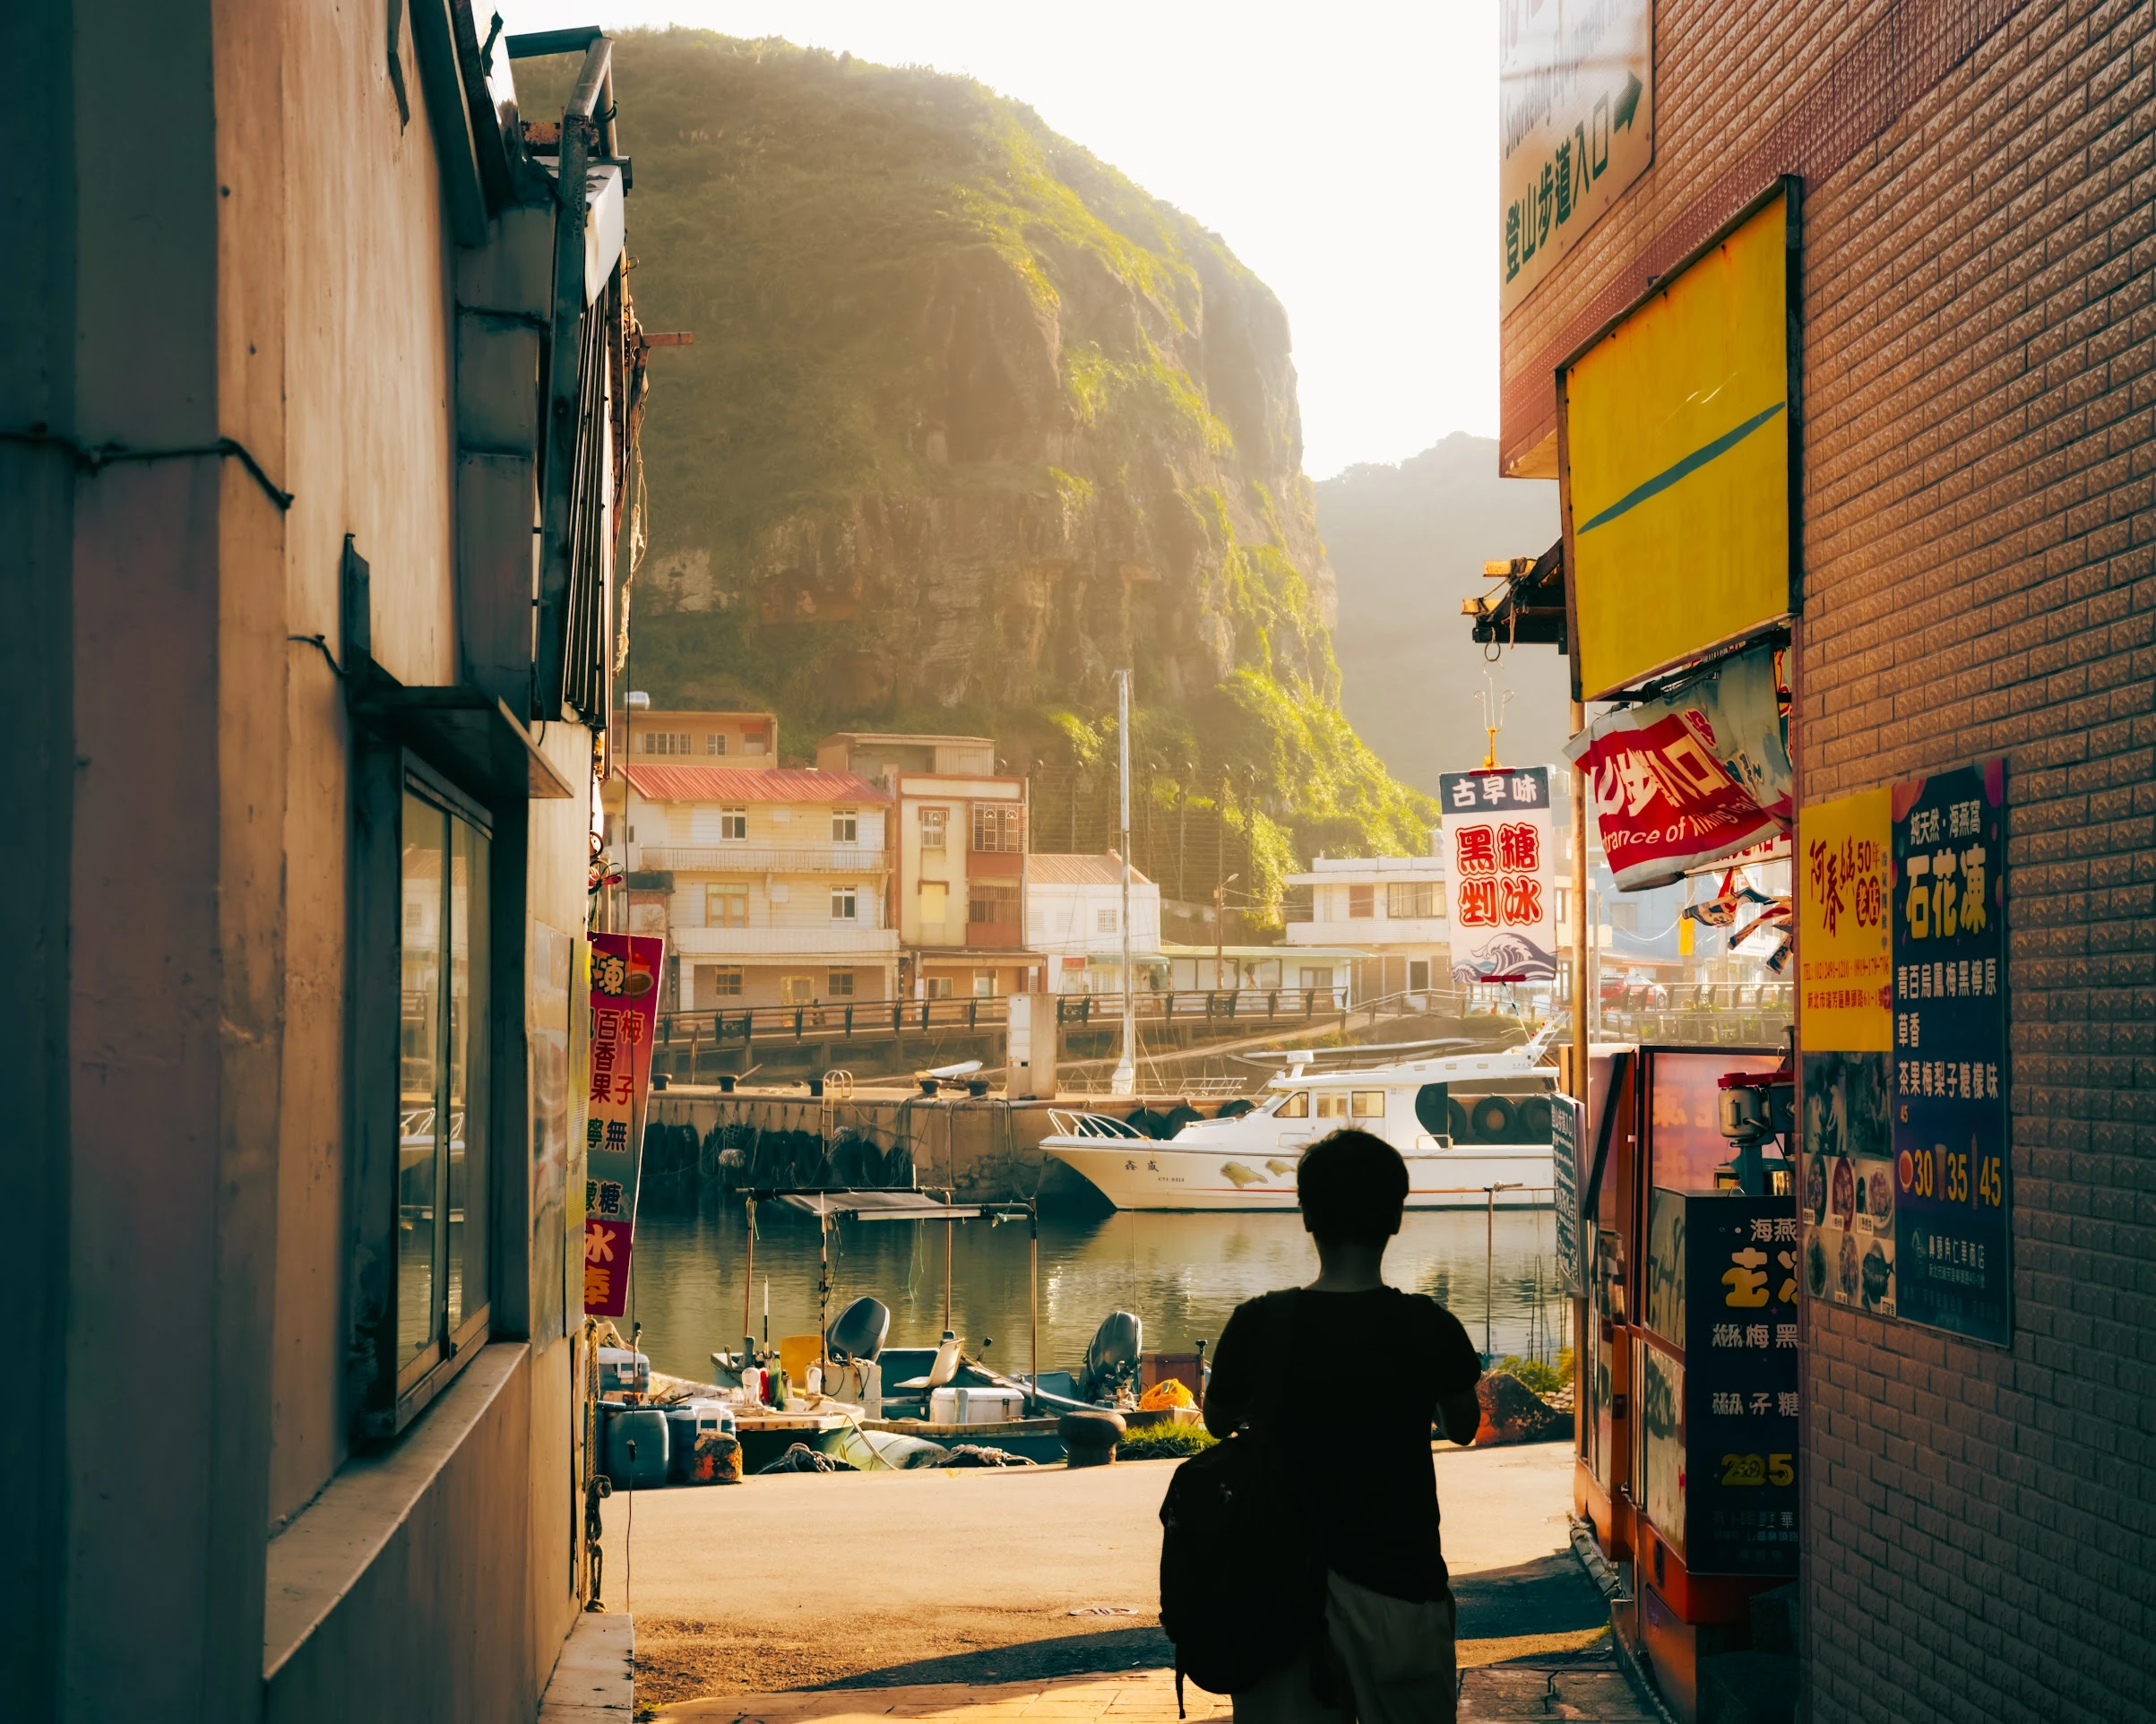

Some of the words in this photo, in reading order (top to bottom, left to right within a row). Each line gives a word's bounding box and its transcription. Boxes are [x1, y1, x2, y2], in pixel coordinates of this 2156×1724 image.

[1506, 91, 1608, 284] 登山步道入口
[1453, 774, 1537, 806] 古早味
[1456, 823, 1539, 875] 黑糖
[1602, 830, 1660, 853] trance
[1666, 816, 1686, 842] of
[1857, 879, 1880, 924] 老店
[1906, 843, 1986, 939] 石花凍
[591, 1009, 620, 1103] 百香果
[1914, 1149, 1933, 1197] 30
[1947, 1152, 1968, 1202] 35
[1980, 1156, 2001, 1207] 45
